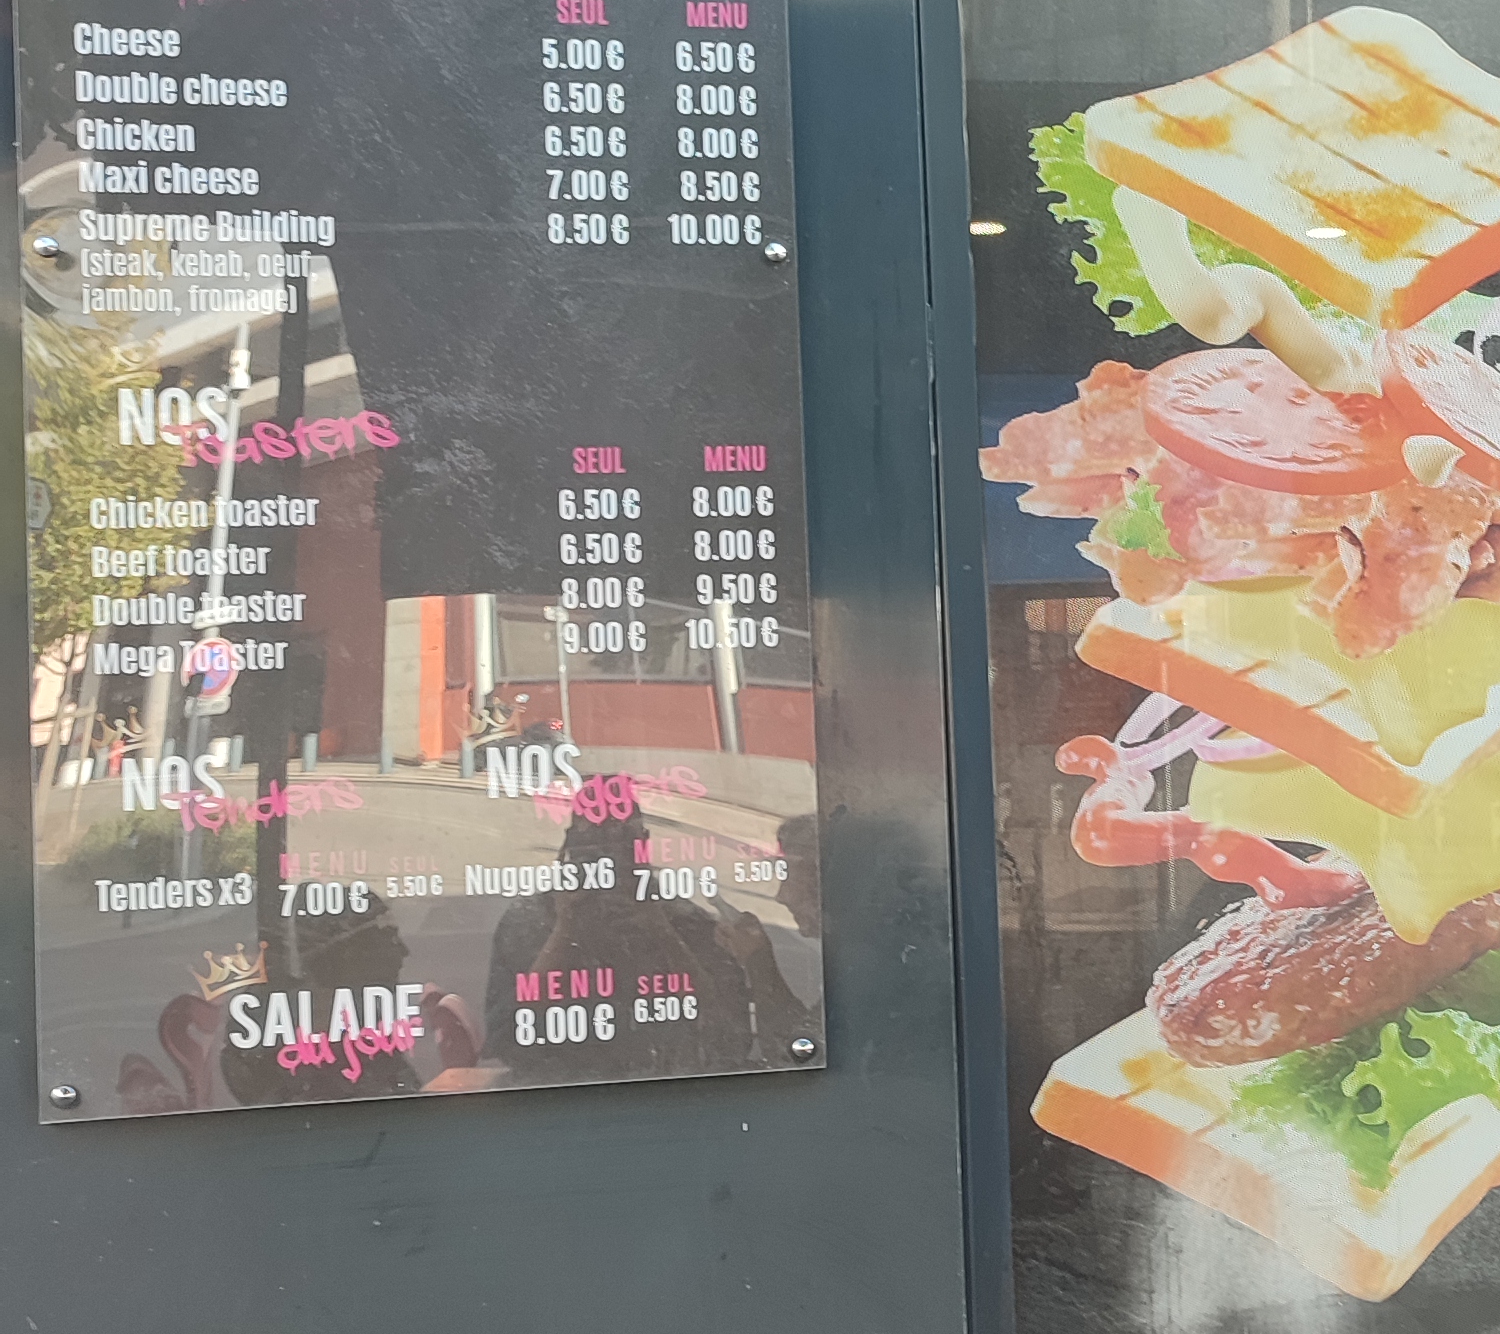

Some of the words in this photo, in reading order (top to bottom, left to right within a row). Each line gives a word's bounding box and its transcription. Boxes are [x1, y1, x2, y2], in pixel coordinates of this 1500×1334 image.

[686, 0, 748, 29] MENU
[73, 22, 181, 57] Cheese
[74, 70, 178, 105] Double
[183, 73, 289, 107] cheese
[76, 117, 196, 152] Chicken
[77, 159, 149, 194] Maxi
[154, 161, 260, 196] cheese
[78, 209, 211, 245] Supreme
[215, 209, 336, 247] Building
[170, 248, 251, 282] kebab,
[81, 284, 182, 316] jambon,
[117, 387, 229, 446] NOS
[572, 447, 627, 474] SEUL
[703, 445, 767, 472] MENU
[89, 495, 209, 530] Chicken
[214, 495, 320, 528] toaster
[90, 544, 160, 579] Beef
[164, 542, 272, 576] toaster
[92, 592, 195, 626] Double
[199, 590, 307, 623] toaster
[92, 642, 175, 677] Mega
[122, 755, 225, 812] NOS
[485, 743, 583, 801] NOS
[279, 850, 368, 879] MENU
[633, 836, 716, 864] MENU
[94, 876, 213, 913] Tenders
[218, 873, 252, 907] x3
[465, 860, 579, 897] Nuggets
[582, 857, 615, 890] x6
[516, 967, 615, 1002] MENU
[637, 972, 694, 996] SEUL
[228, 983, 425, 1049] SALADE
